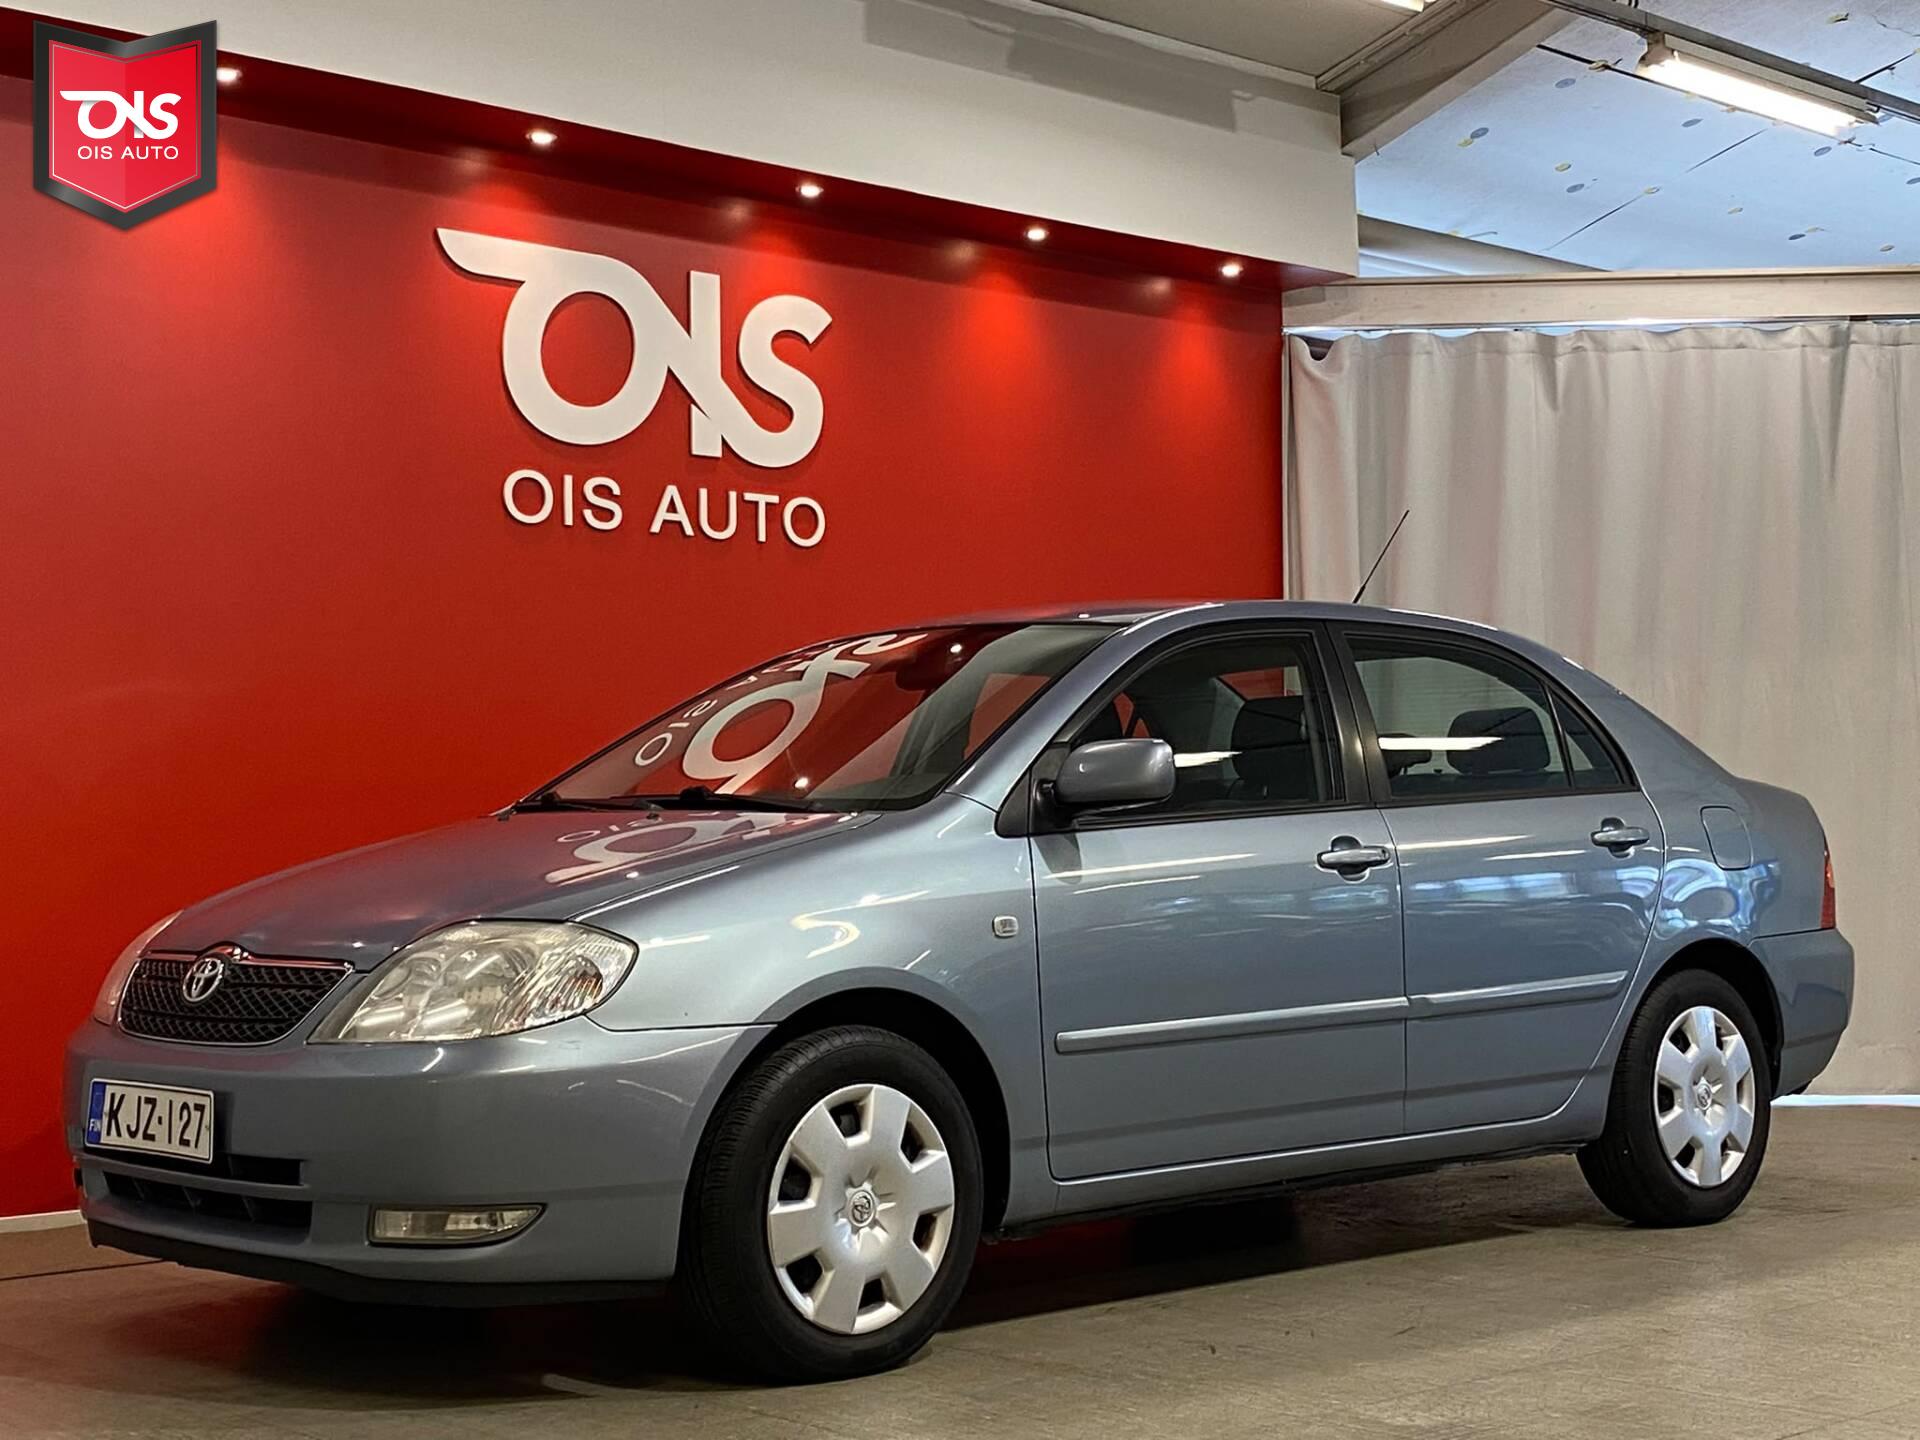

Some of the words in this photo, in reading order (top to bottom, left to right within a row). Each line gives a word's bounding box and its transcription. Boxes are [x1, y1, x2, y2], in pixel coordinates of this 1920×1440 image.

[436, 228, 833, 467] OIS
[503, 469, 623, 531] OIS
[649, 484, 826, 547] AUTO
[106, 1092, 206, 1149] KJZ-127
